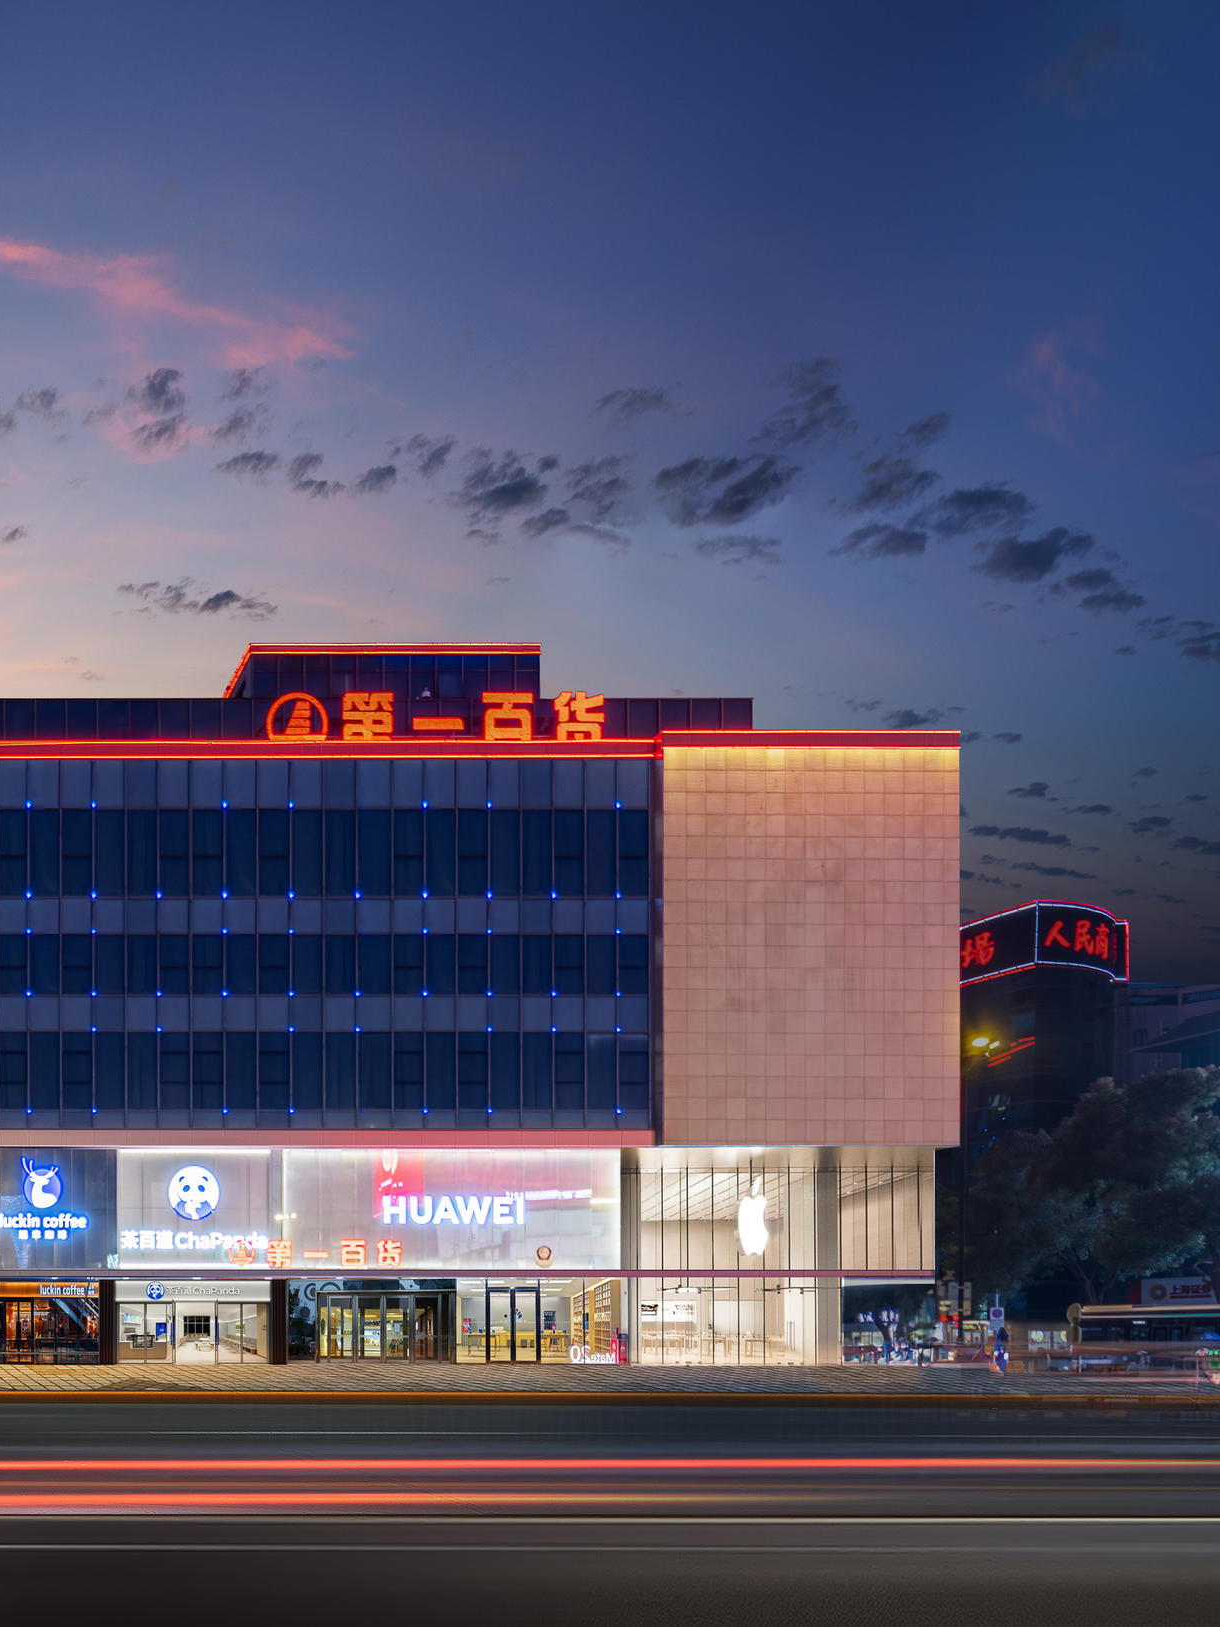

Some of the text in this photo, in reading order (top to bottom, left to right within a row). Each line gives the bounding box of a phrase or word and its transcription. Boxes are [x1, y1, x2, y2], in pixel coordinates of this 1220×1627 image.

[342, 691, 605, 740] 第一百货
[1043, 919, 1118, 966] 人民商
[0, 1213, 87, 1229] luckin coffee
[382, 1195, 525, 1225] HUAWEI
[267, 1239, 402, 1269] 第一百货
[40, 1285, 61, 1295] luckin
[63, 1284, 85, 1295] coffee
[193, 1286, 240, 1296] ChaPanda
